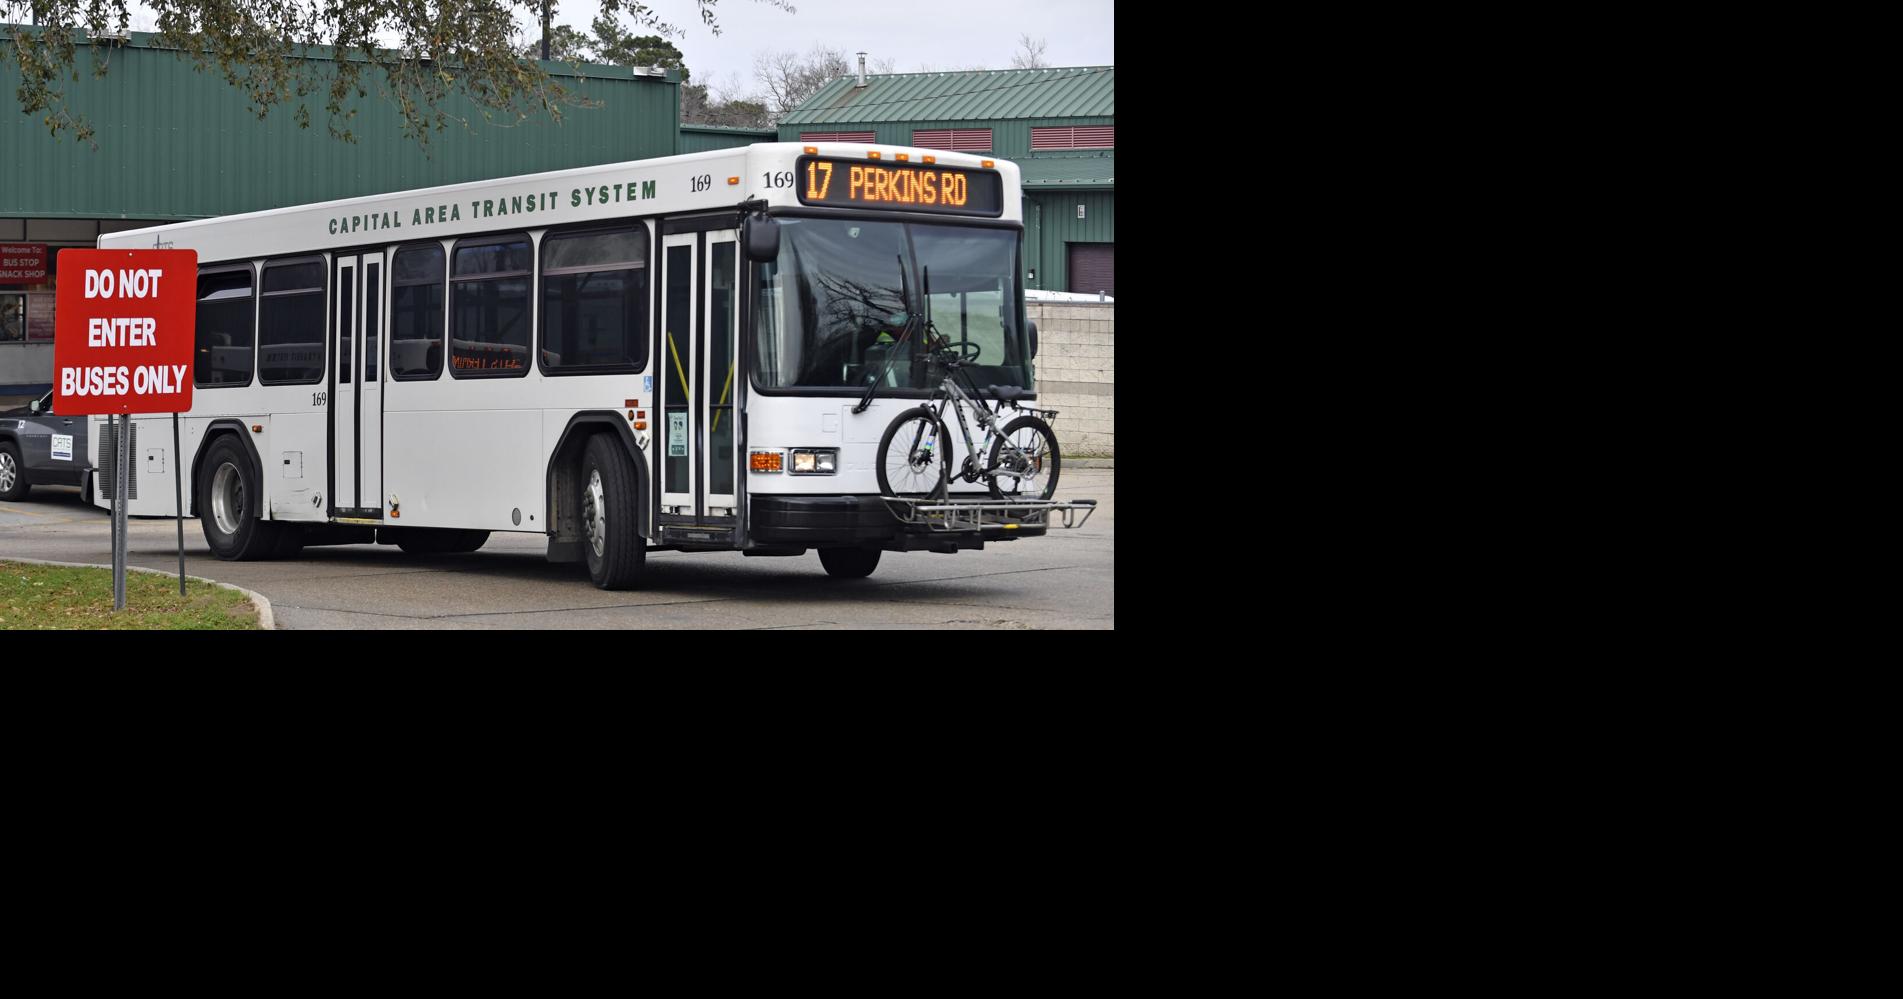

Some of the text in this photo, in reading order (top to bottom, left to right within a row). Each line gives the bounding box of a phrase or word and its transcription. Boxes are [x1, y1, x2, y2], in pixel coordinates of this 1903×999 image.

[690, 174, 711, 192] 169
[763, 171, 794, 188] 169
[807, 161, 967, 205] 17 PERKINS RD
[328, 180, 656, 235] CAPITAL AREA TRANSIT SYSTEM
[3, 258, 40, 266] BUS STOP
[24, 270, 46, 278] SHOP
[84, 268, 163, 299] DO NOT
[88, 317, 157, 347] ENTER
[61, 364, 187, 396] BUSES ONLY
[312, 391, 327, 406] 169
[53, 437, 71, 448] CATS
